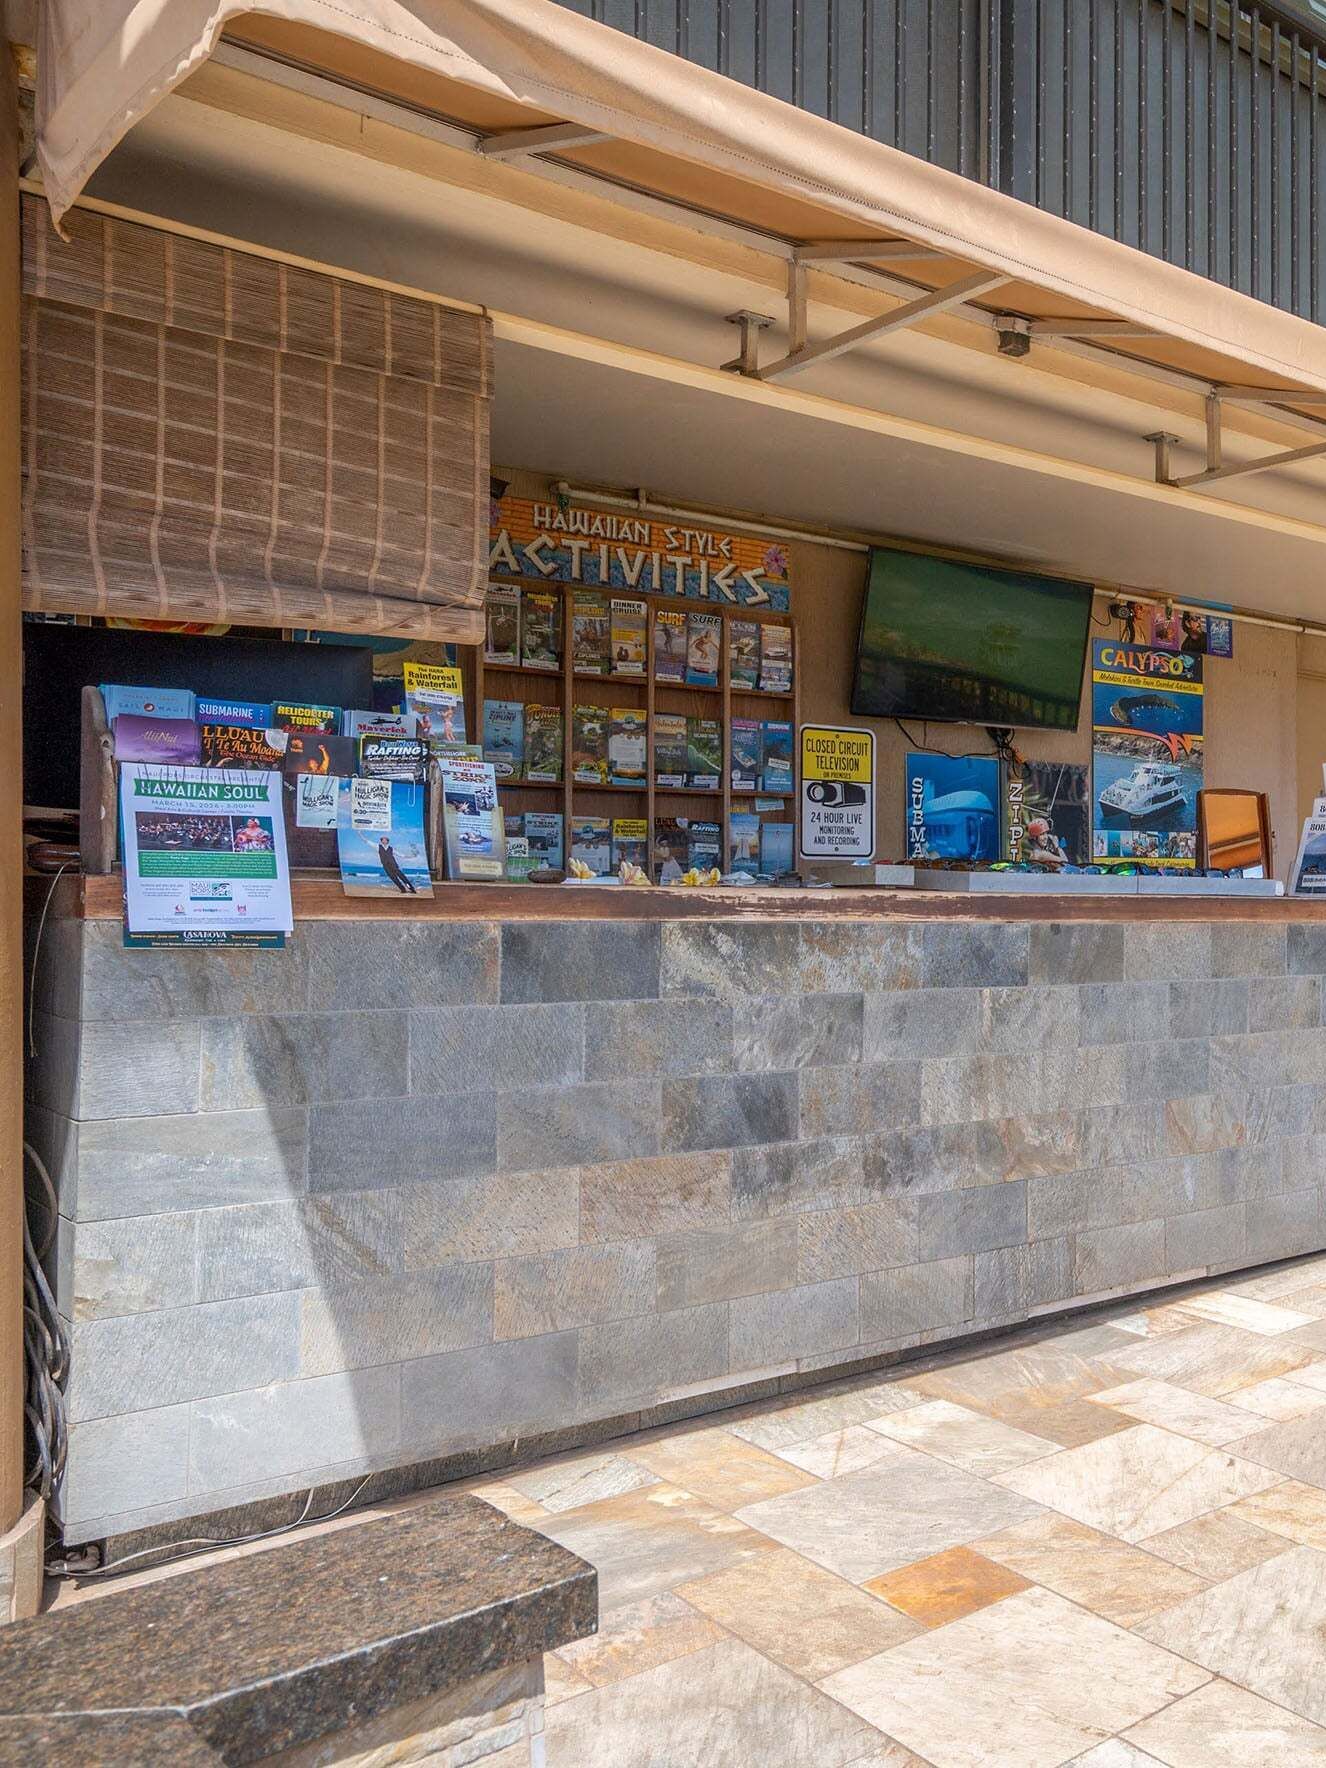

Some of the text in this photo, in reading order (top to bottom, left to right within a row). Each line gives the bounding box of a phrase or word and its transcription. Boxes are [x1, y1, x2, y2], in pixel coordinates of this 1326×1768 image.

[533, 503, 732, 559] HAWAIIAN STYLE
[487, 528, 770, 605] ACTIVITIES
[613, 601, 642, 609] DINNER
[657, 610, 687, 626] SURF
[692, 614, 720, 625] SURF
[1100, 647, 1184, 675] CALYPSO
[408, 671, 456, 682] Rainforest
[416, 680, 458, 689] Waterfall
[199, 704, 253, 719] SUBMARINE
[277, 706, 335, 719] HELICOPTER
[290, 716, 321, 726] TOURS
[357, 724, 408, 734] Maverick
[249, 743, 285, 757] Moana
[367, 744, 421, 757] RAFTING
[806, 738, 868, 757] CLOSED CIRCUIT
[448, 761, 485, 769] SPORTFISHING
[816, 755, 860, 772] TELEVISION
[823, 771, 852, 780] ON PREMISES
[140, 780, 264, 800] HAWAIIAN SOUL
[811, 811, 863, 825] 24 HOUR LIVE
[691, 824, 721, 833] RAFTING
[819, 825, 855, 836] MONITORING
[813, 835, 860, 847] AND RECORDING
